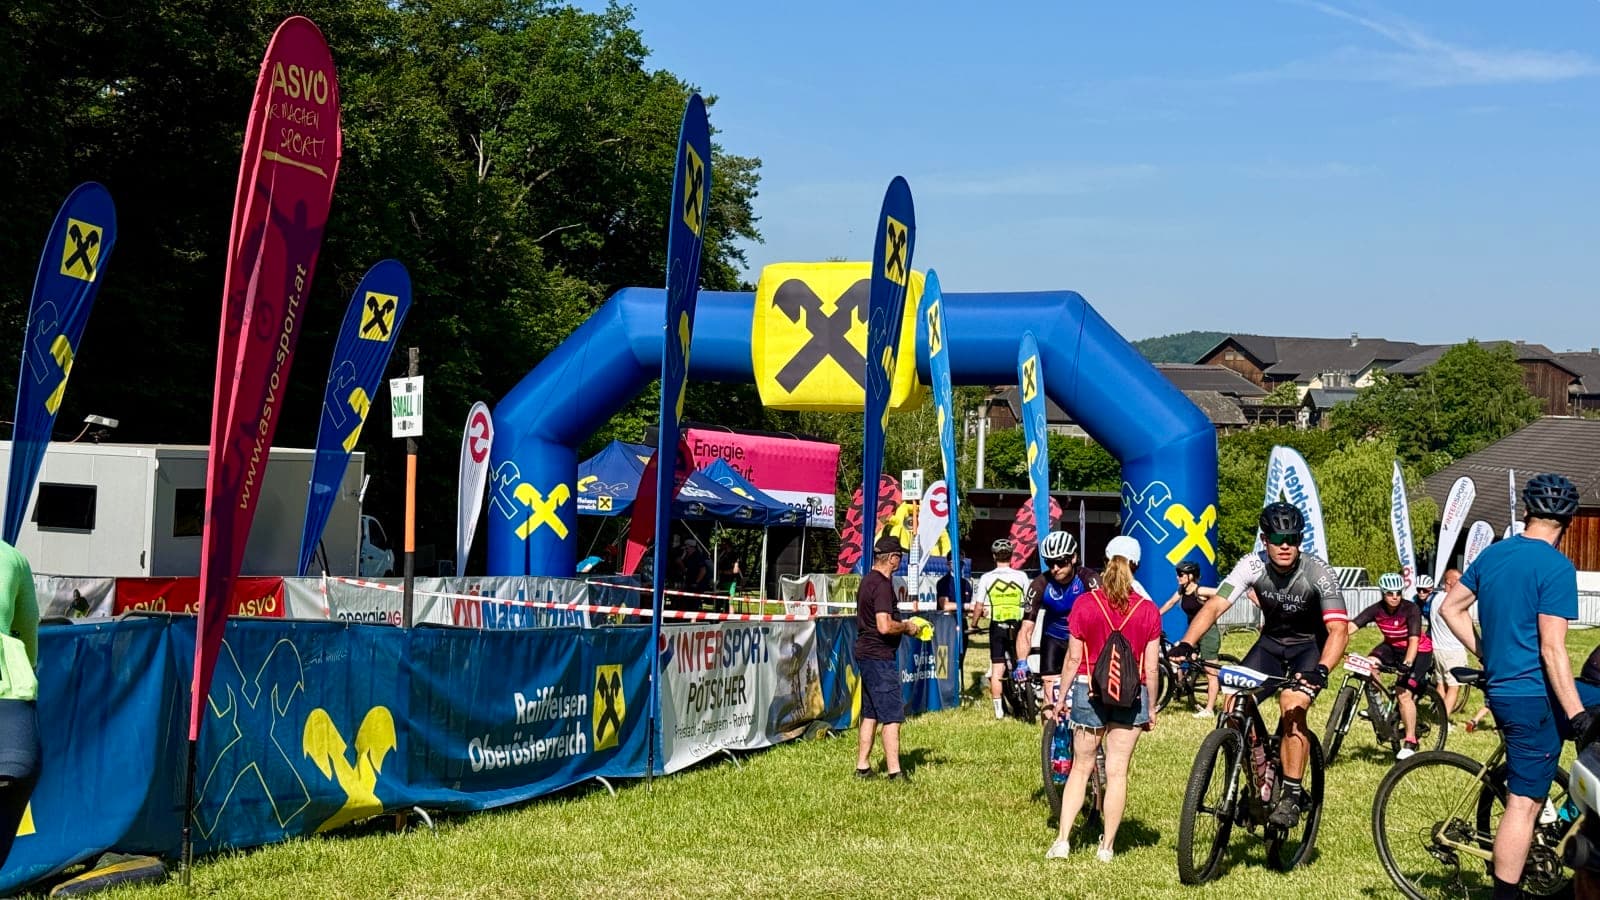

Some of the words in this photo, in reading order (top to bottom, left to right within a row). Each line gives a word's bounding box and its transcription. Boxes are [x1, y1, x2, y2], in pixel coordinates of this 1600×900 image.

[272, 61, 329, 105] ASVÖ
[392, 394, 414, 418] SMALL
[693, 438, 746, 463] Energie.
[238, 594, 277, 617] ASVÖ
[676, 627, 770, 674] INTERSPORT
[513, 685, 588, 725] Raiffeisen
[686, 674, 748, 715] PÖTSCHER
[468, 720, 588, 773] Oberösterreich
